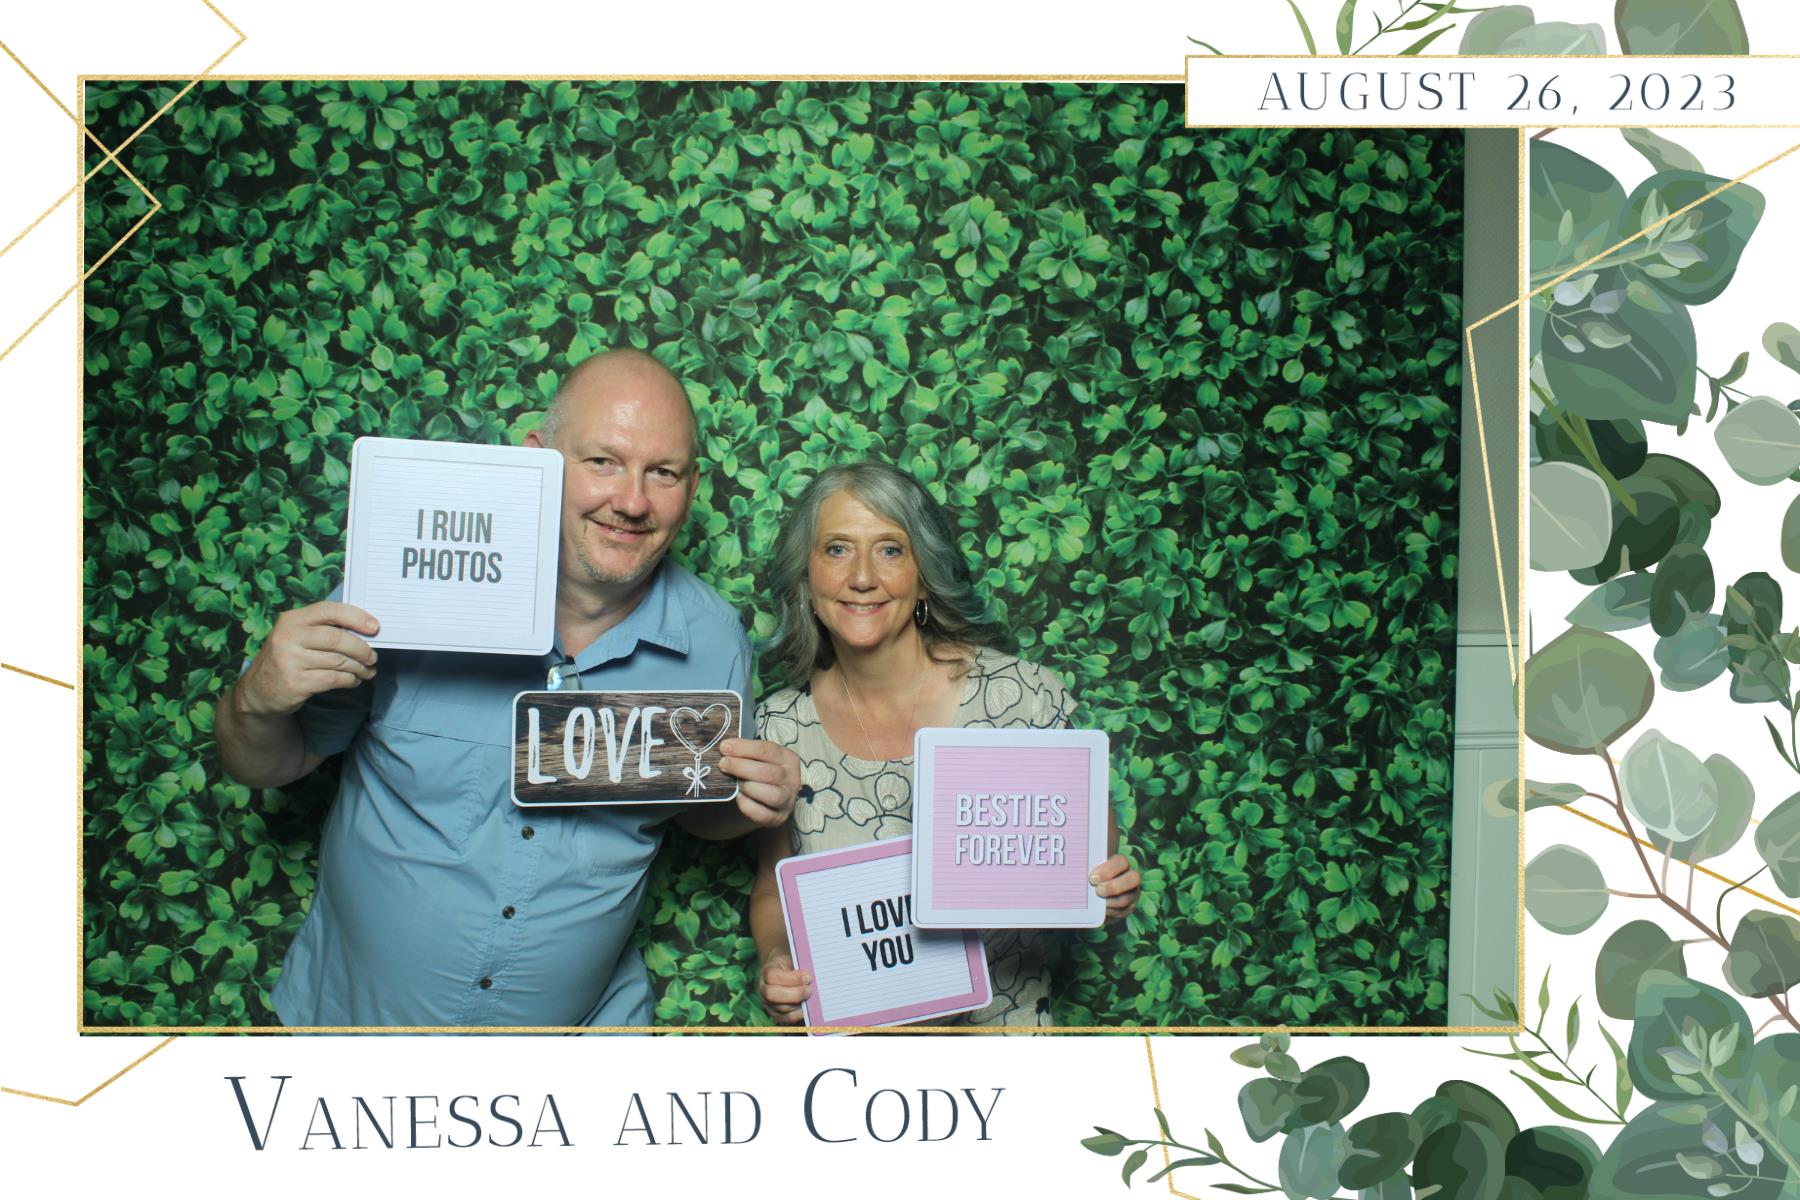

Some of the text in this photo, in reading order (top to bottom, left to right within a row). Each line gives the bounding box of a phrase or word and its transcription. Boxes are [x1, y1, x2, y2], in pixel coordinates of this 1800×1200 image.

[416, 509, 493, 544] I RUIN
[401, 547, 503, 584] PHOTOS
[527, 706, 667, 785] LOVE
[954, 793, 1067, 827] BESTIES
[954, 833, 1066, 866] FOREVER
[840, 907, 852, 938] I
[860, 932, 915, 972] YOU
